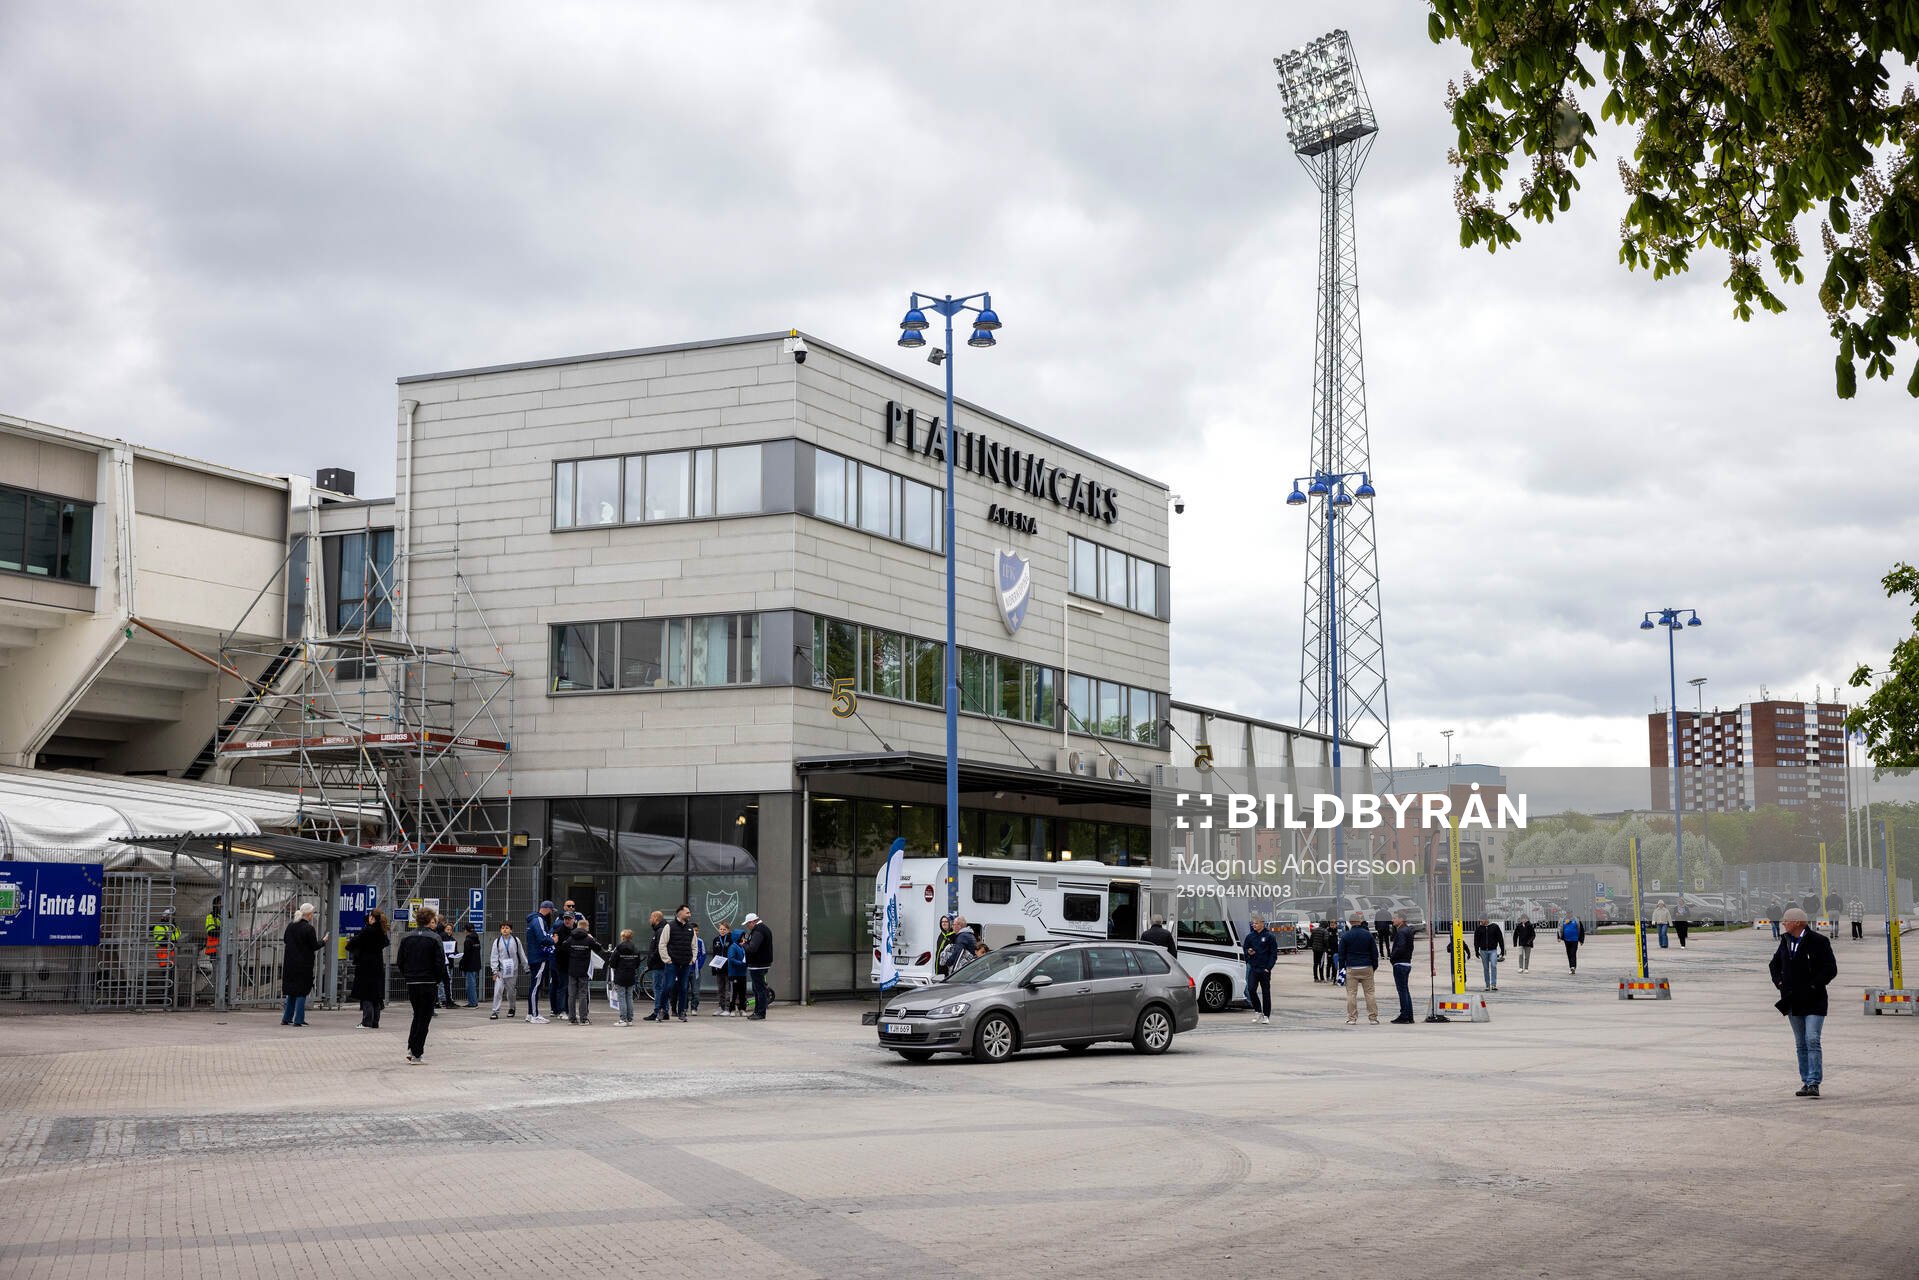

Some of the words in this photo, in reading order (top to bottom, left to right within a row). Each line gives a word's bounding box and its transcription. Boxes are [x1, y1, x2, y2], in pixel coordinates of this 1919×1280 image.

[886, 400, 1118, 524] PLATINUMCARS
[988, 504, 1038, 535] ARENA
[831, 677, 857, 718] 5
[380, 733, 408, 741] LIBERGS
[455, 846, 478, 854] LIBERGS
[39, 893, 75, 916] Entré
[78, 894, 97, 916] 4B
[339, 892, 354, 912] ntré
[354, 892, 365, 912] 4B
[368, 887, 376, 907] P
[473, 891, 482, 909] P
[710, 898, 723, 906] IFK
